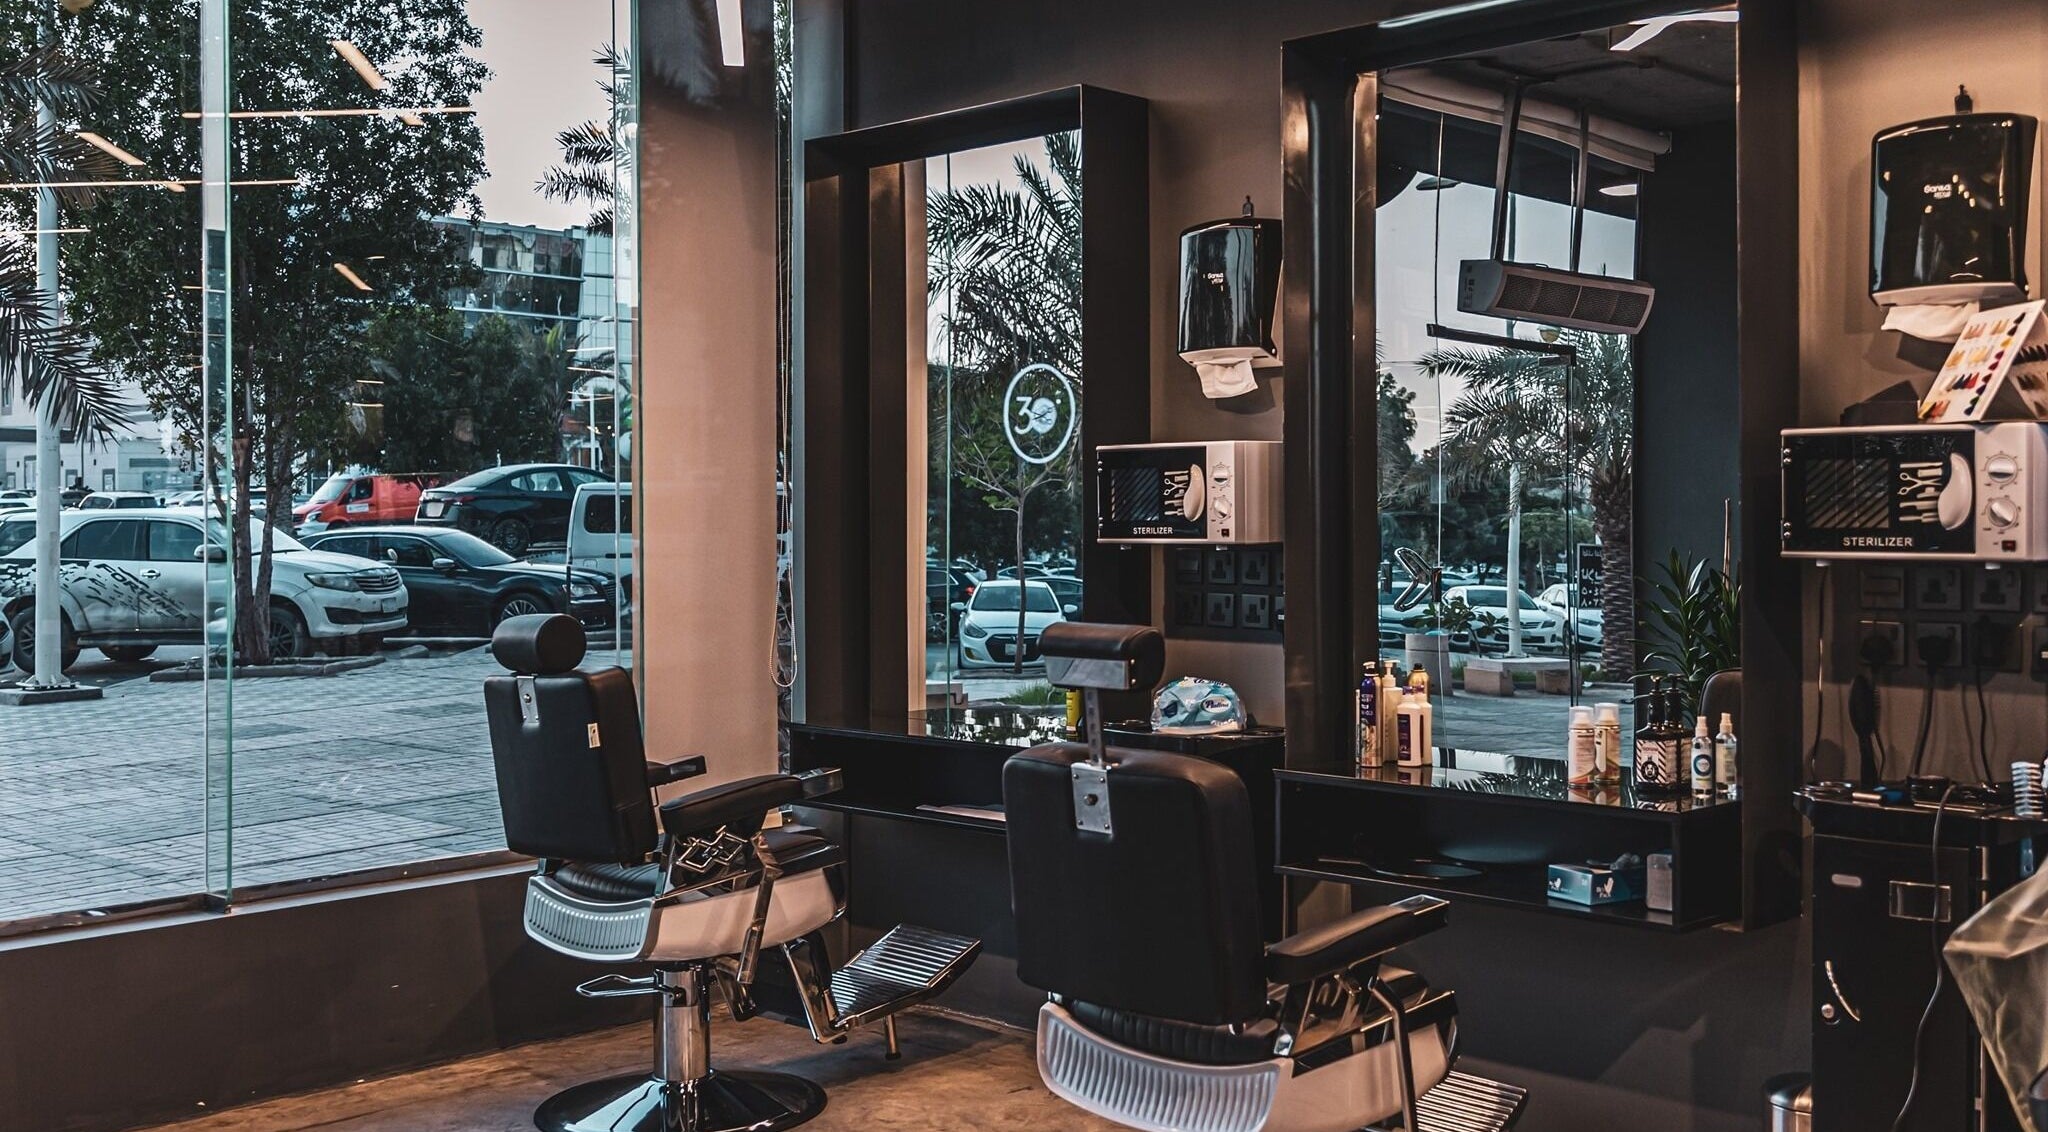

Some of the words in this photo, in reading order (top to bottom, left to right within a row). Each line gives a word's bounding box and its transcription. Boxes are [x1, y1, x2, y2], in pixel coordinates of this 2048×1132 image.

[1133, 526, 1174, 535] STERILIZER
[1842, 536, 1913, 547] STERILIZER
[94, 563, 188, 621] FORTUNER
